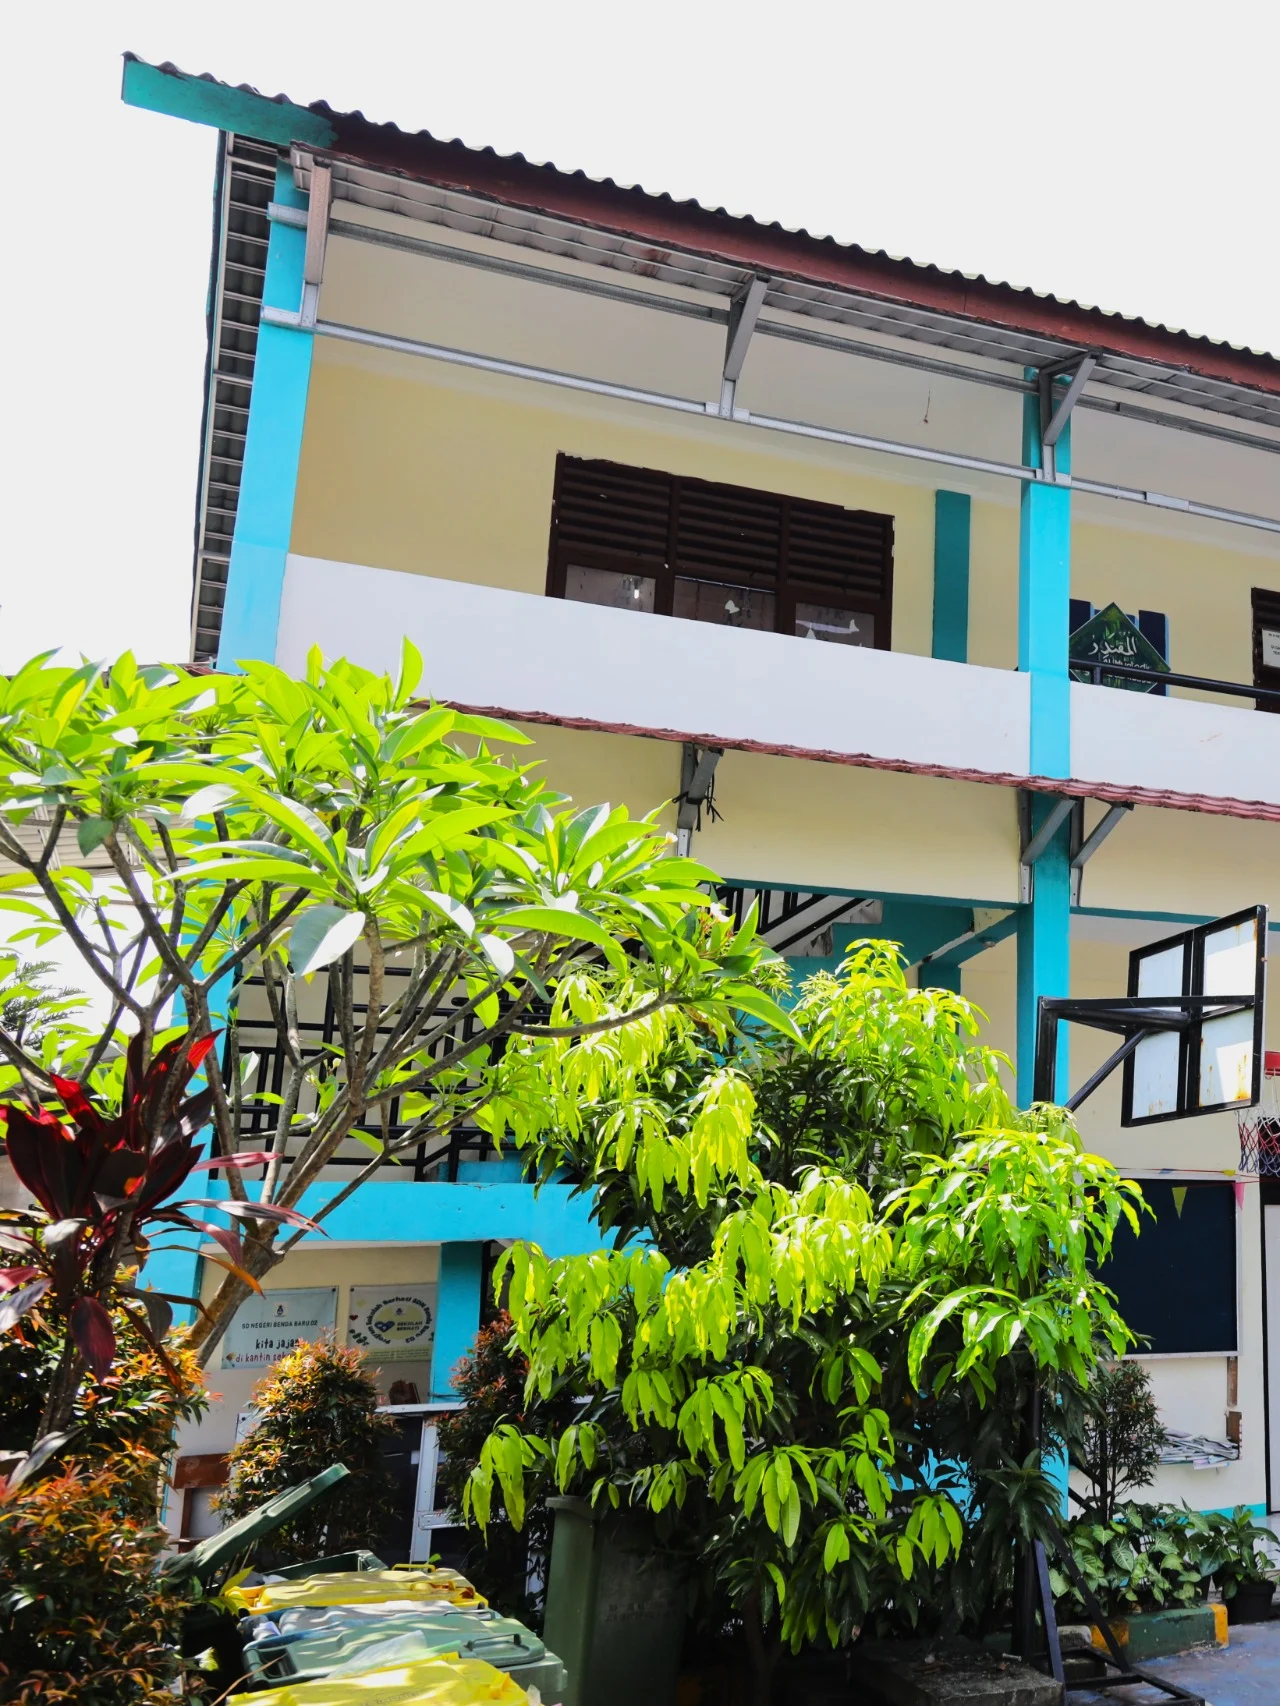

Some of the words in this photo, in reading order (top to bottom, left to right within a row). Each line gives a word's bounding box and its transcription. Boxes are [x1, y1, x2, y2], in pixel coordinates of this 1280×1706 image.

[382, 1296, 412, 1305] Berhati
[412, 1297, 427, 1308] SDN
[250, 1322, 272, 1330] NEGERI
[294, 1320, 310, 1328] BARU
[310, 1319, 318, 1327] 02
[255, 1338, 274, 1350] kita
[235, 1353, 243, 1363] di
[245, 1352, 271, 1363] kantin
